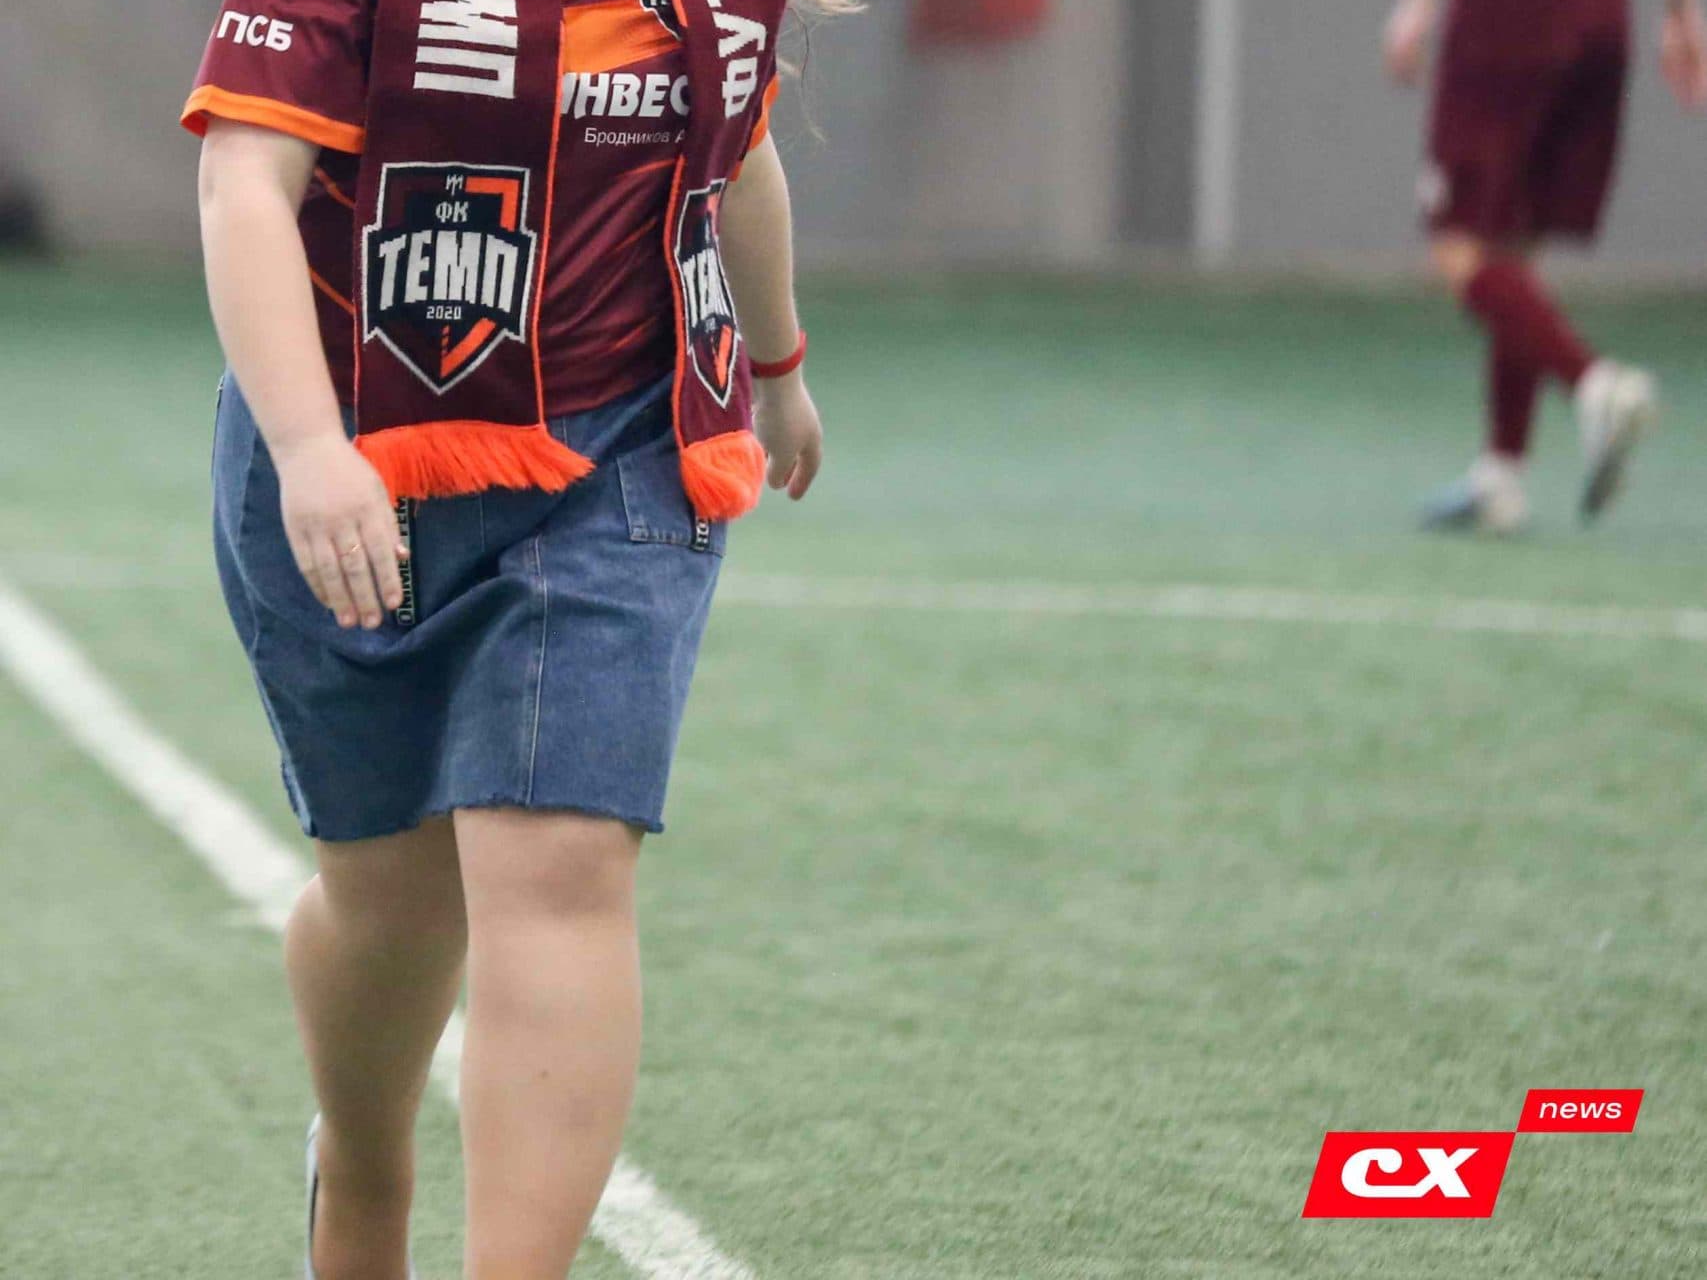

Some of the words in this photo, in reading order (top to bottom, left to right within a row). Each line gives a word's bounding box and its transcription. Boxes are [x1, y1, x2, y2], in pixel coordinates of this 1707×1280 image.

[216, 10, 294, 52] ПСБ
[584, 127, 670, 147] Бродников
[435, 201, 470, 223] ФК
[378, 229, 519, 313] ТЕМП
[426, 306, 462, 320] 2020
